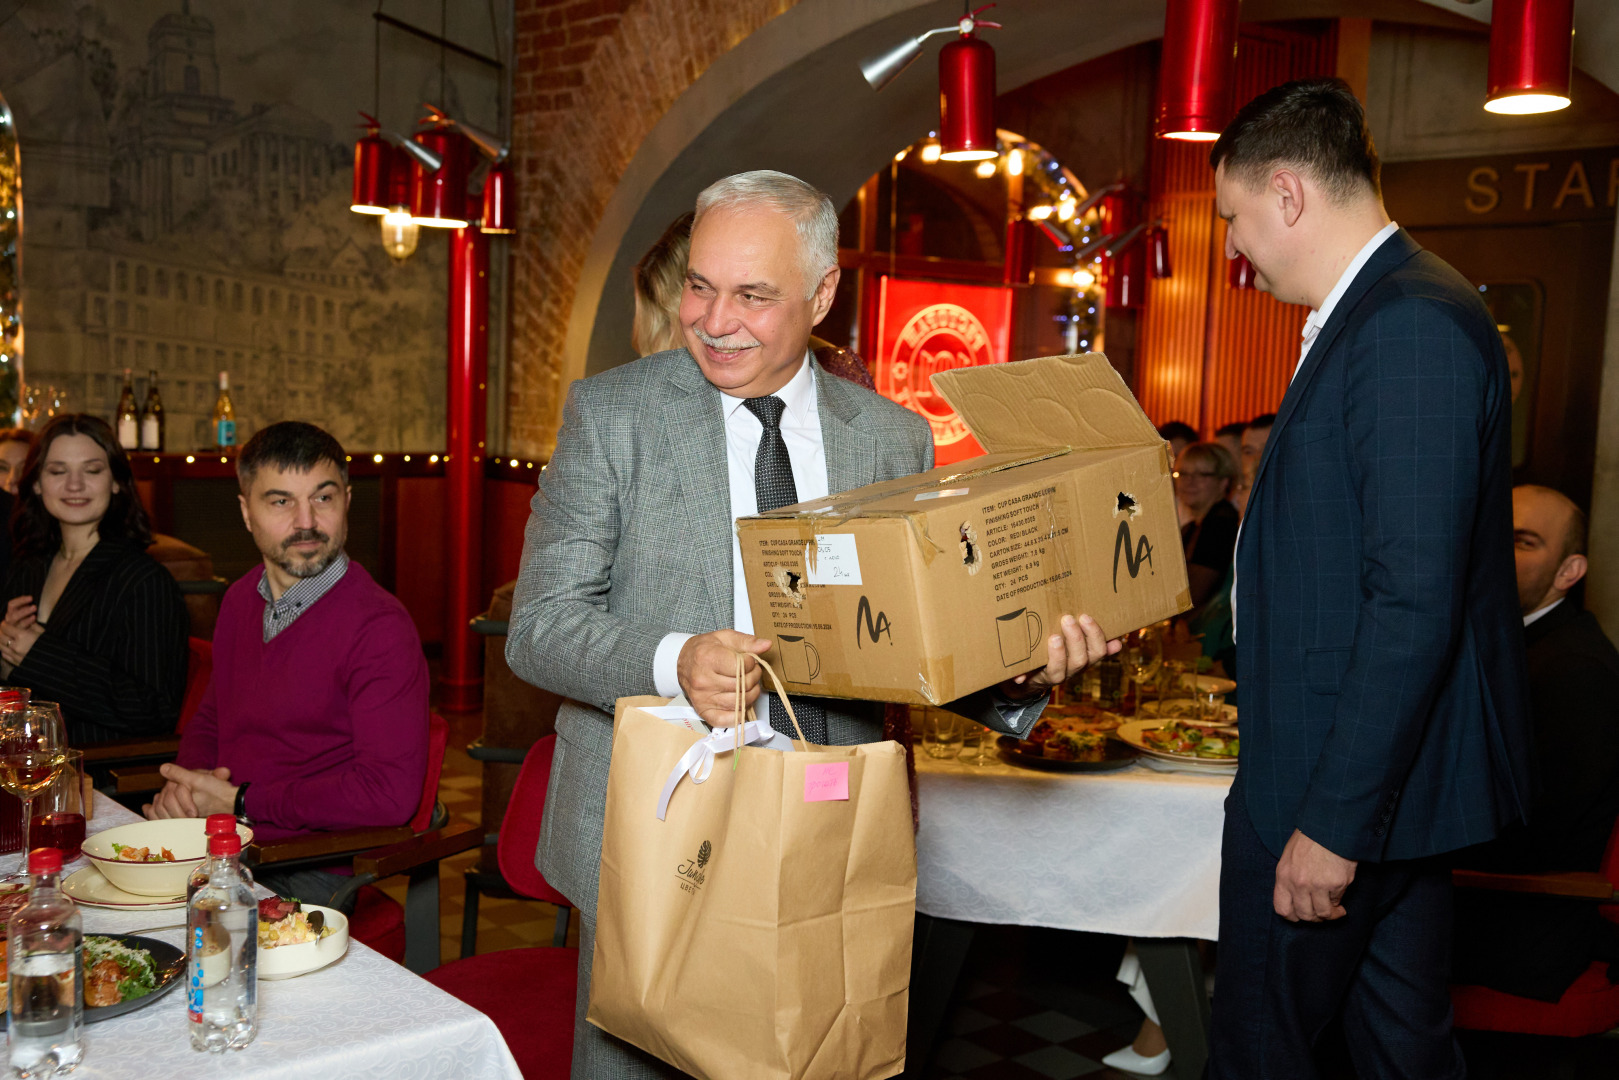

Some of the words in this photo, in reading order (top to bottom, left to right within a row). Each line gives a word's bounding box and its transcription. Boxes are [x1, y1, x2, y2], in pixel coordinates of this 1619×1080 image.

[982, 505, 996, 515] ITEM:
[997, 500, 1008, 510] CUP
[1008, 496, 1022, 506] CASA
[1021, 490, 1041, 502] GRANDE
[985, 512, 1010, 525] FINISHING
[1010, 508, 1023, 518] SOFT
[1023, 503, 1040, 514] TOUCH
[986, 524, 1009, 536] ARTICLE:
[987, 536, 1006, 548] COLOR:
[989, 545, 1010, 558] CARTON
[1010, 543, 1023, 552] SIZE:
[991, 558, 1009, 569] GROSS
[1009, 552, 1029, 563] WEIGHT:
[993, 571, 1004, 580] NET
[1003, 565, 1024, 577] WEIGHT:
[994, 582, 1007, 592] QTY:
[1018, 574, 1029, 583] PCS
[996, 592, 1010, 602] DATE
[1017, 578, 1049, 595] PRODUCTION:
